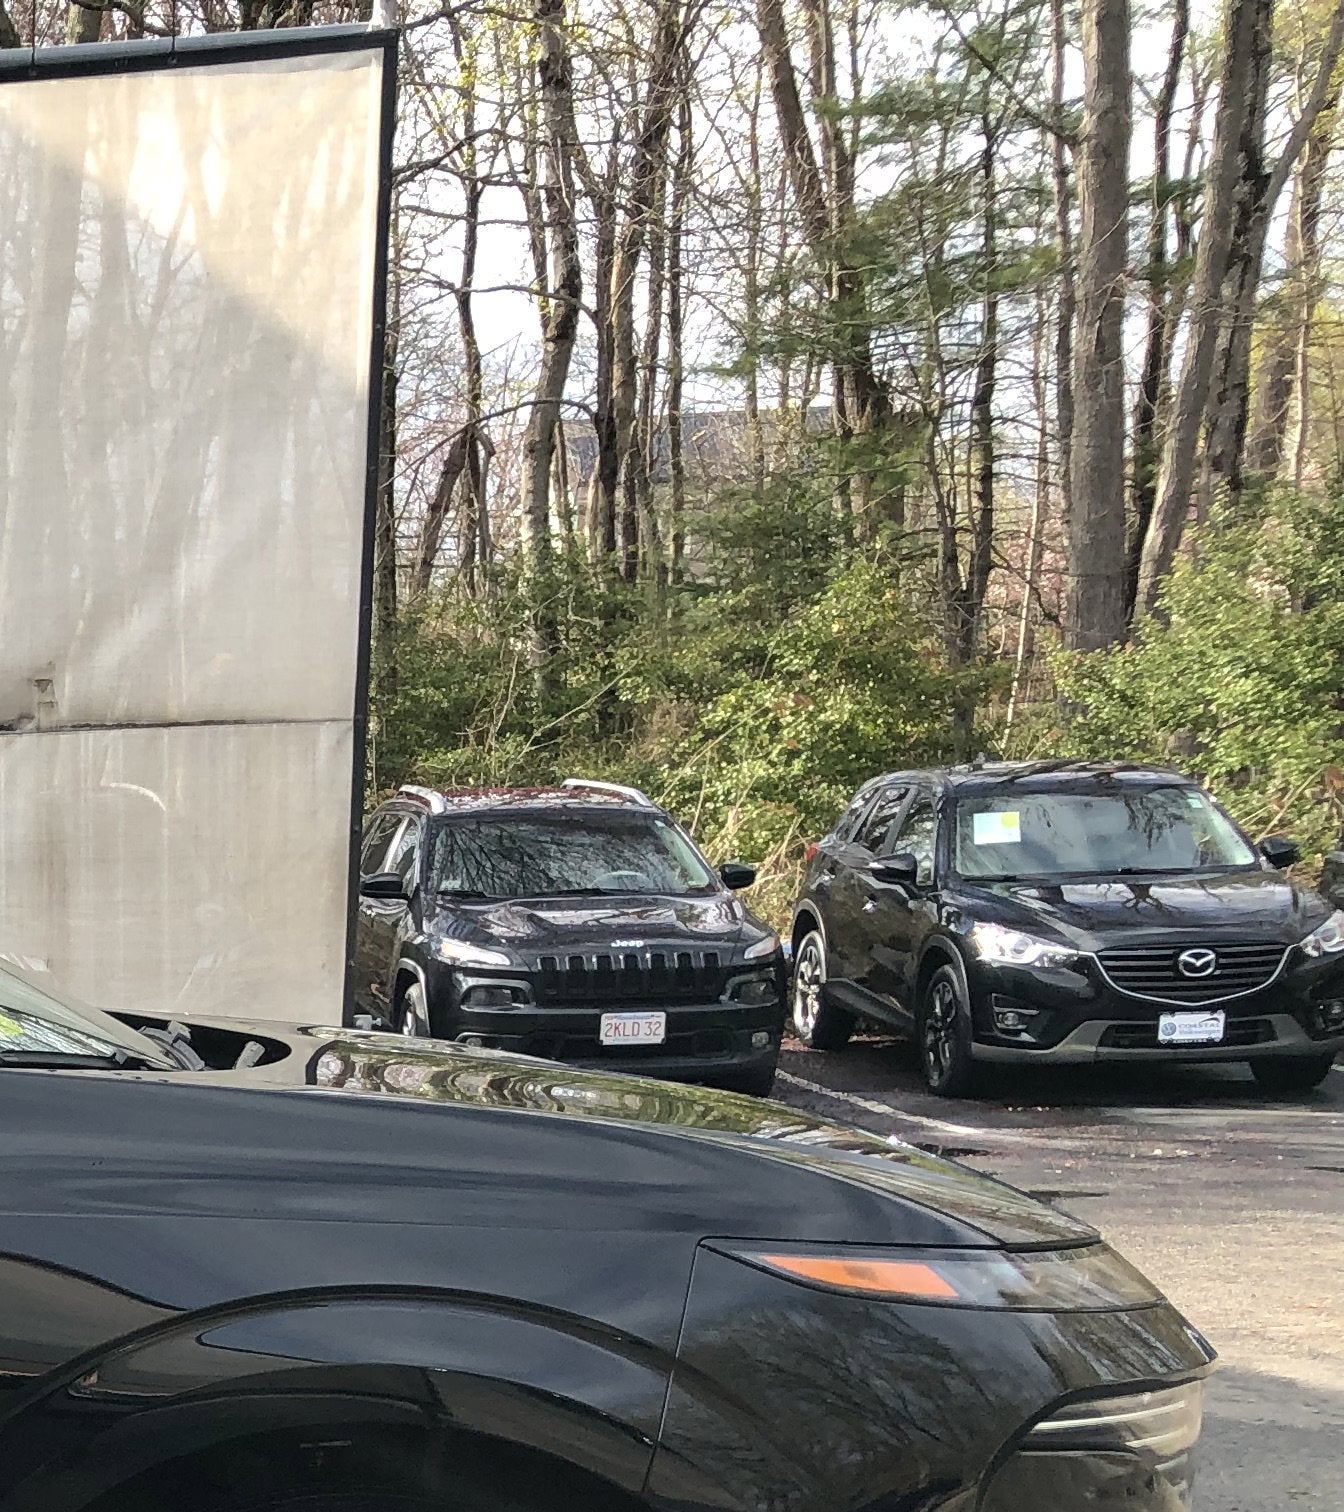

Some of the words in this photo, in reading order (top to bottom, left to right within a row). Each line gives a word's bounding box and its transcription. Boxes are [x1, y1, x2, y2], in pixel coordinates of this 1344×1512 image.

[610, 939, 645, 948] Jeep
[604, 1022, 640, 1038] 2KLD
[644, 1021, 662, 1036] 32
